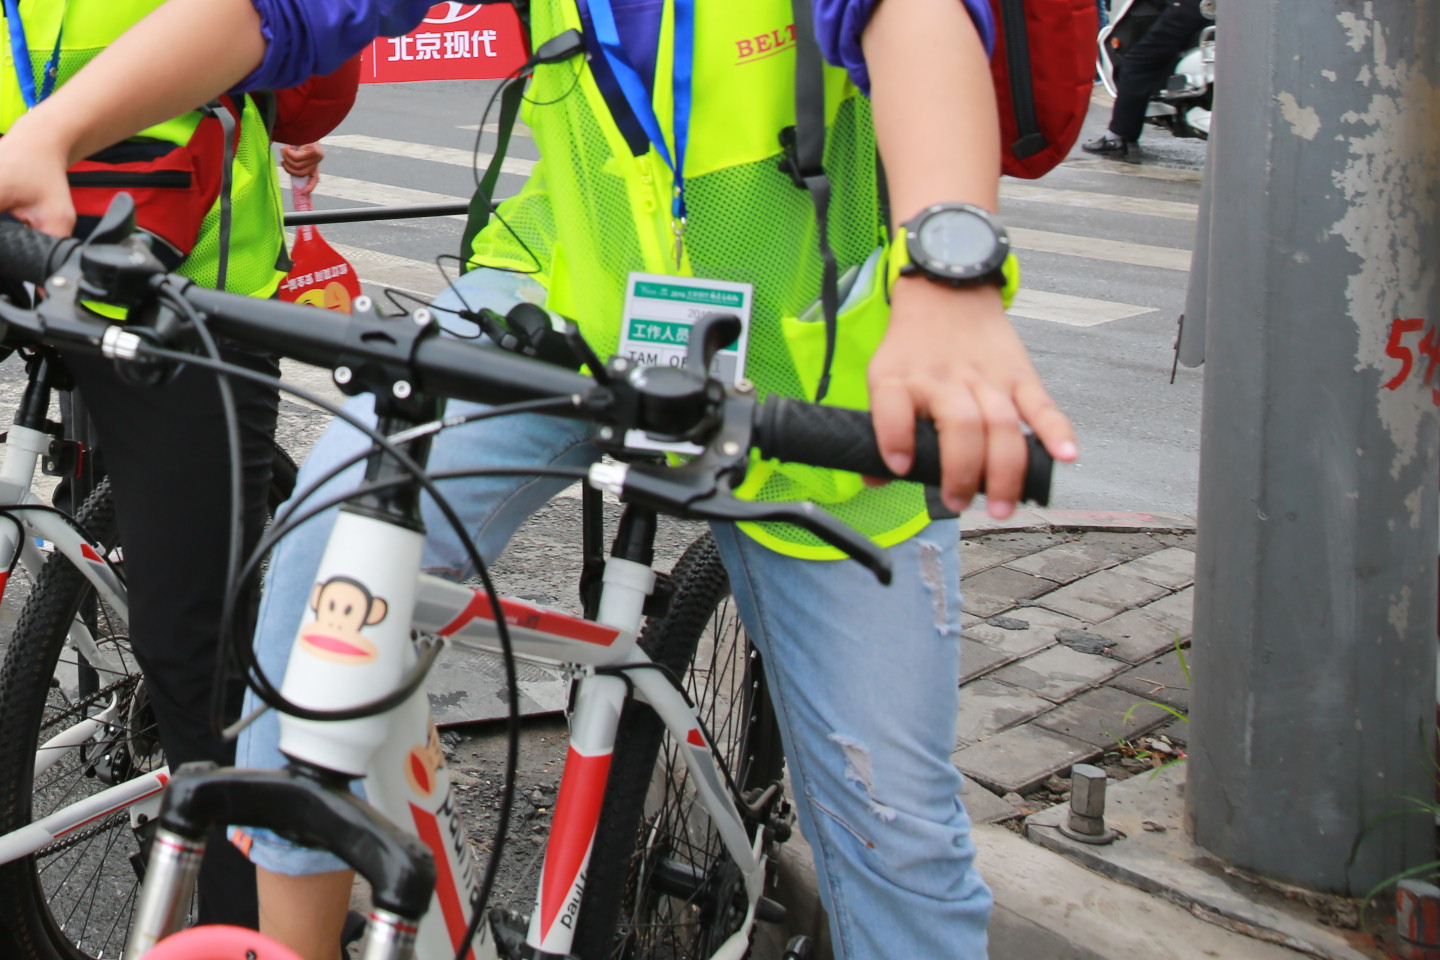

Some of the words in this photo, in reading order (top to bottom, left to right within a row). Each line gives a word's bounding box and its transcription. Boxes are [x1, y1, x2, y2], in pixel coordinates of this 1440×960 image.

[387, 29, 497, 62] 北京现代
[735, 23, 797, 59] BELT
[632, 323, 689, 342] 工作人员
[560, 883, 585, 930] paul
